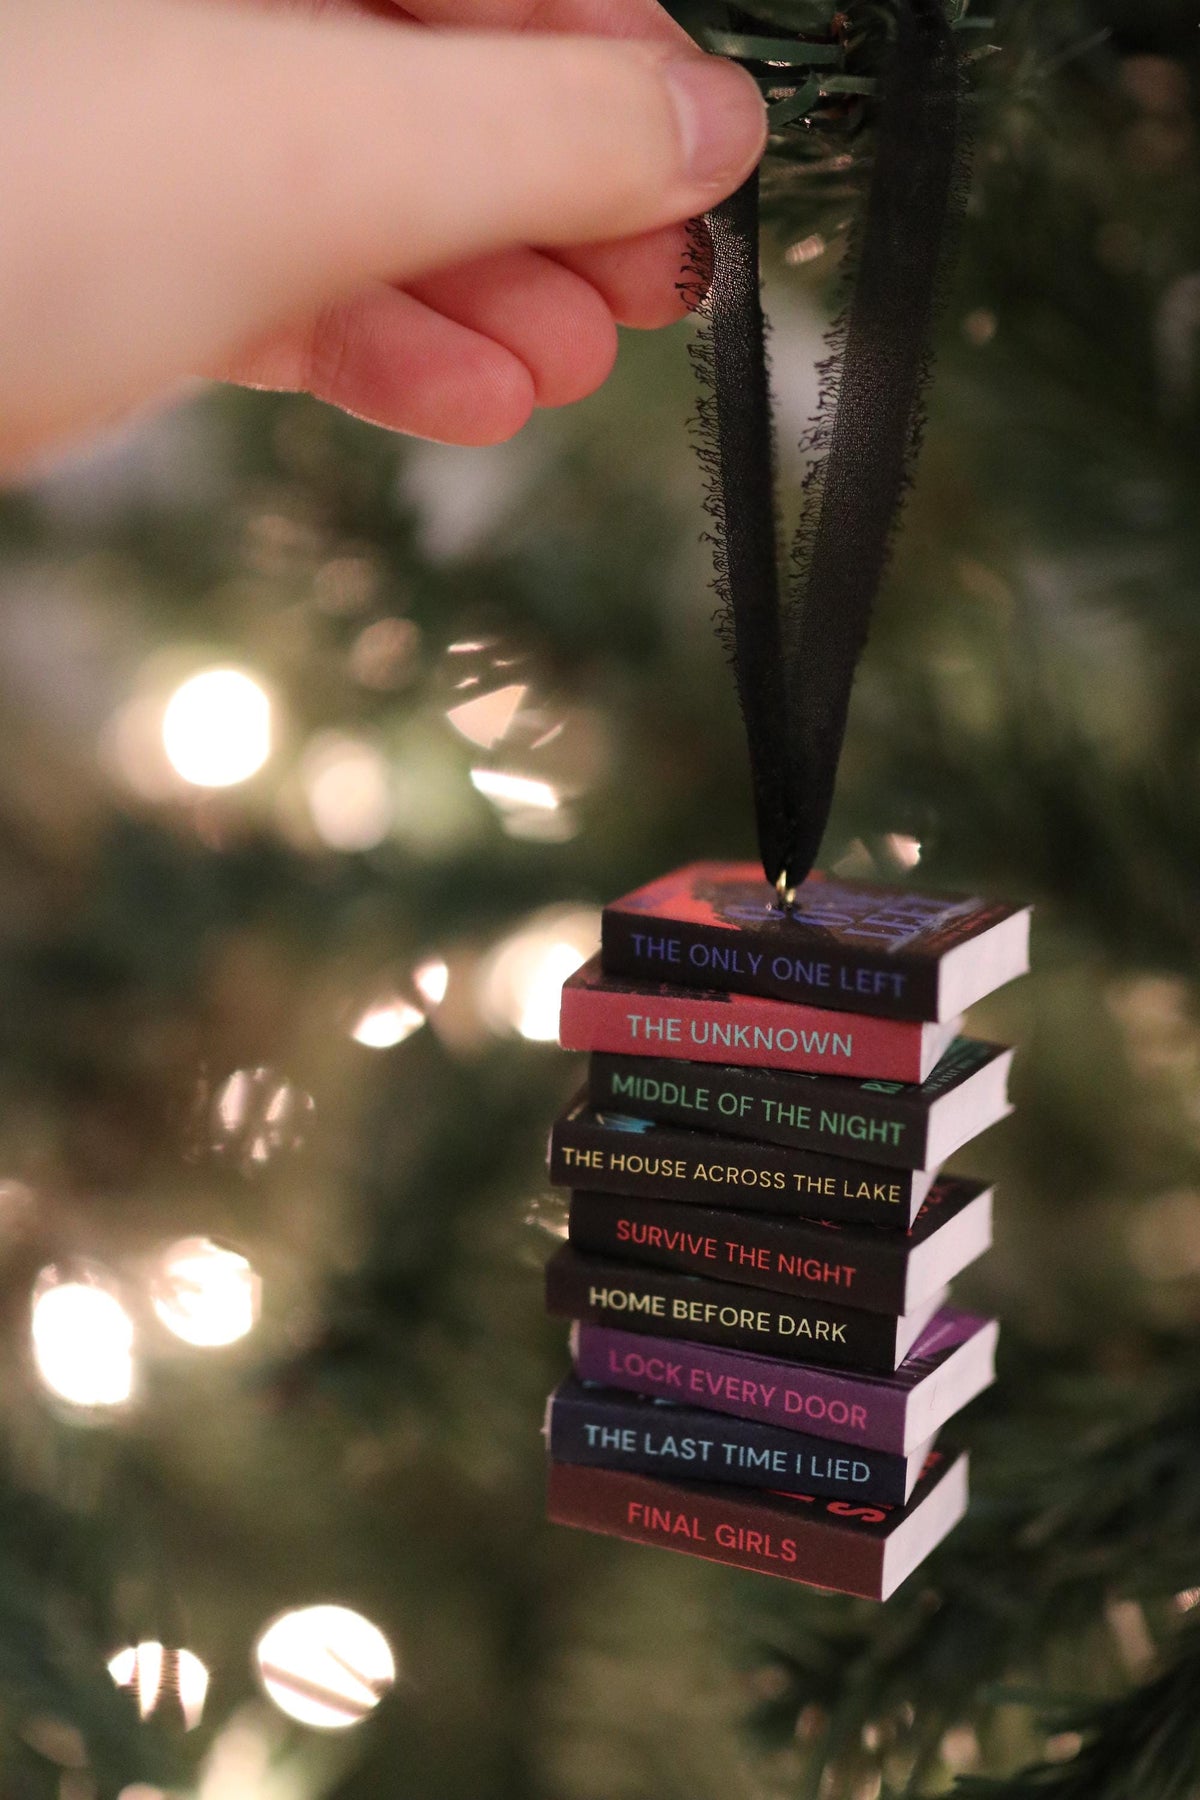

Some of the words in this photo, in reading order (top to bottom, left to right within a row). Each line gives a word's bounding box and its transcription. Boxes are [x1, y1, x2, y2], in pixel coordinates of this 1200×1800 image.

[631, 934, 681, 963] THE
[689, 944, 763, 975] ONLY
[772, 957, 831, 987] ONE
[840, 966, 907, 998] LEFT
[627, 1014, 681, 1042] THE
[691, 1020, 853, 1057] UNKNOWN
[612, 1073, 709, 1110] MIDDLE
[718, 1092, 753, 1117] OF
[761, 1100, 810, 1129] THE
[820, 1113, 905, 1146] NIGHT
[561, 1147, 604, 1169] THE
[610, 1154, 686, 1179] HOUSE
[693, 1163, 785, 1189] ACROSS
[793, 1174, 836, 1195] THE
[844, 1181, 901, 1203] LAKE
[616, 1219, 717, 1258] SURVIVE
[726, 1242, 770, 1270] THE
[778, 1253, 857, 1288] NIGHT
[589, 1286, 665, 1316] HOME
[672, 1300, 770, 1332] BEFORE
[778, 1315, 847, 1343] DARK
[608, 1349, 682, 1387] LOCK
[690, 1369, 777, 1407] EVERY
[784, 1390, 868, 1429] DOOR
[585, 1424, 636, 1451] THE
[644, 1435, 714, 1462] LAST
[722, 1443, 786, 1472] TIME
[796, 1454, 801, 1474] I
[811, 1456, 870, 1483] LIED
[627, 1502, 706, 1541] FINAL
[715, 1523, 797, 1562] GIRLS
